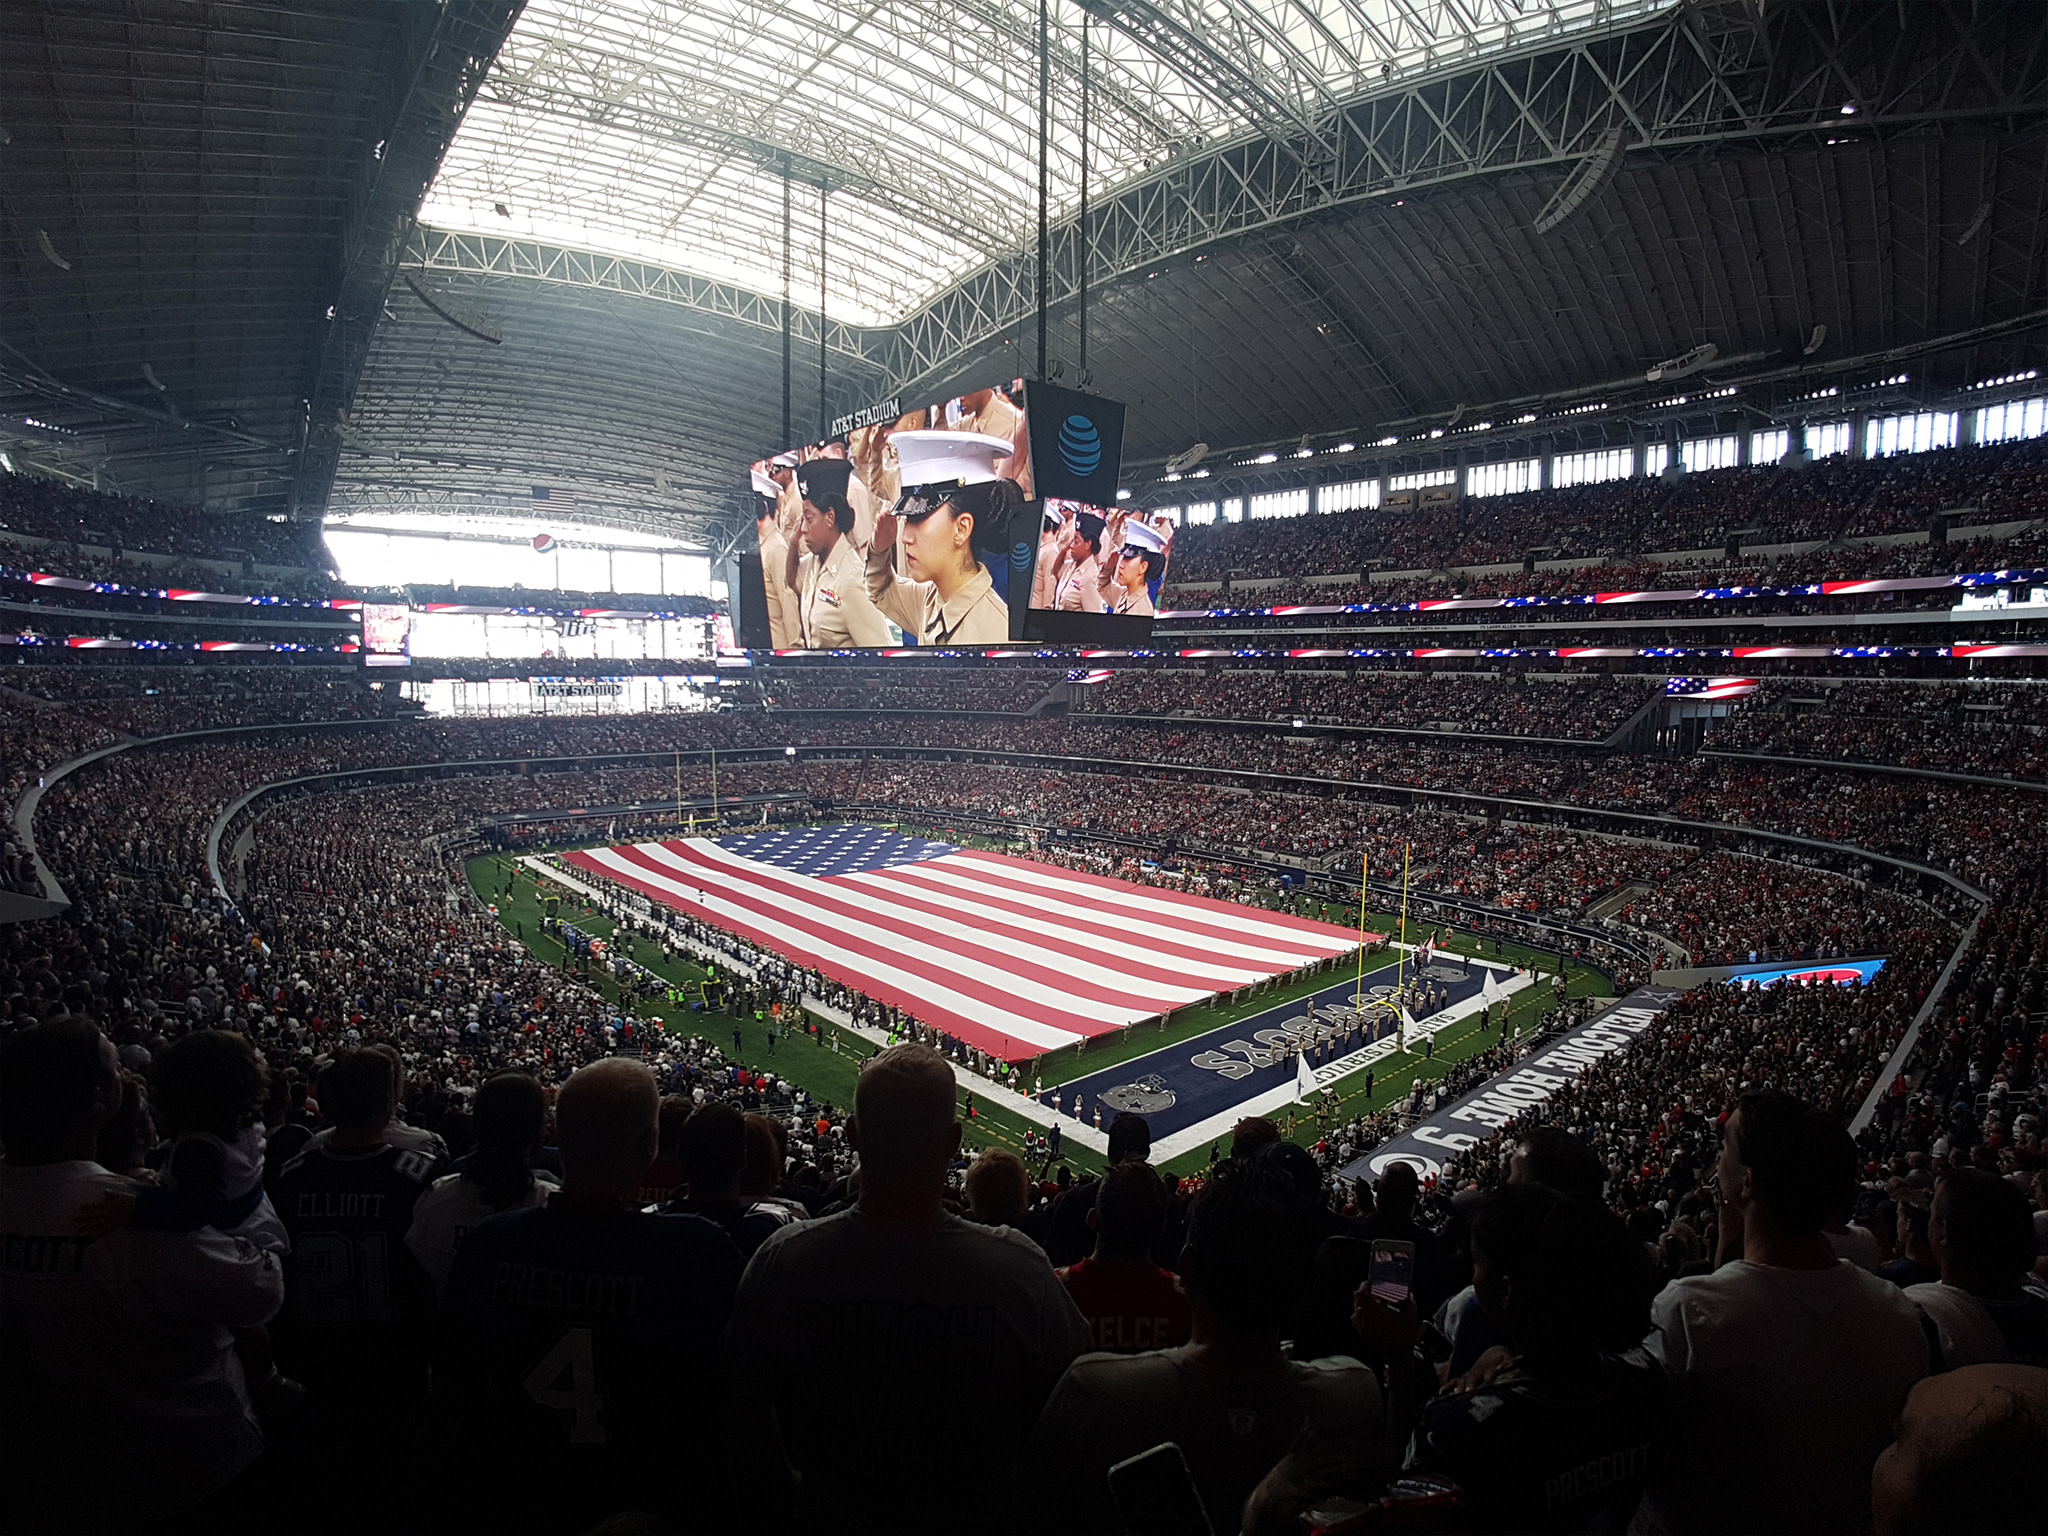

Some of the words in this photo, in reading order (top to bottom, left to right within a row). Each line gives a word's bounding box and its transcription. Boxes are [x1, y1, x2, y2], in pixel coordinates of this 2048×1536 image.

[831, 413, 853, 437] AT&T
[854, 398, 900, 428] STADIUM
[540, 685, 569, 696] AT&T
[571, 685, 622, 696] STADIUM
[1533, 1006, 1665, 1073] WELCOME
[1448, 1068, 1568, 1129] HOME
[296, 1193, 385, 1218] ELLIOTT
[0, 1234, 93, 1272] COTT
[295, 1230, 398, 1326] 21
[491, 1261, 645, 1316] PRESCOTT
[521, 1322, 609, 1446] 4
[1543, 1441, 1652, 1510] PRESCOTT
